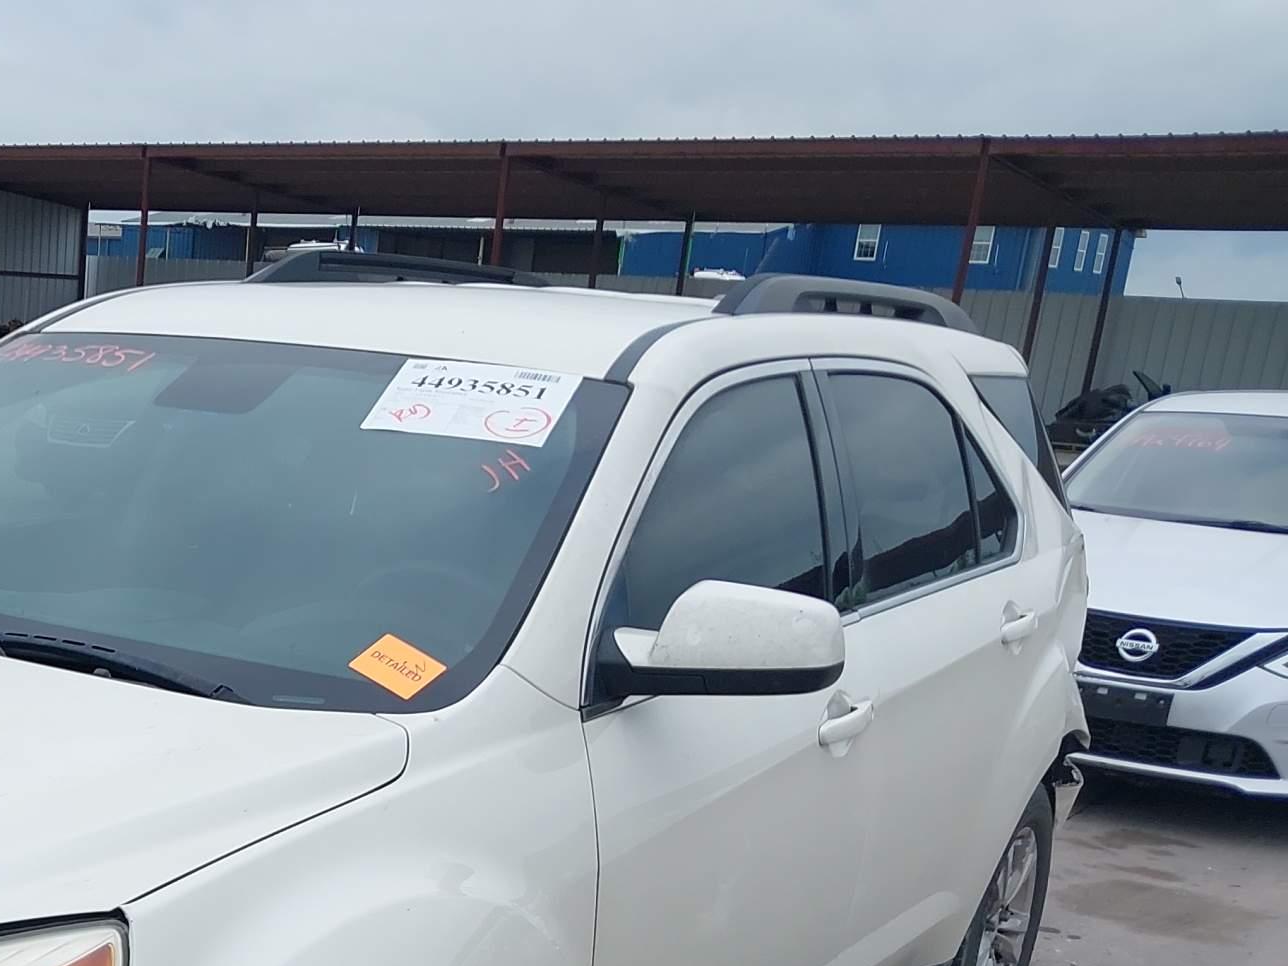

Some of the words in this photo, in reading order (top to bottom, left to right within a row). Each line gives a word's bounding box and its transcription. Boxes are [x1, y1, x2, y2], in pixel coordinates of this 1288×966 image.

[411, 374, 548, 400] 44935851
[1118, 640, 1154, 650] NISSAN
[370, 650, 422, 682] DETAILED
